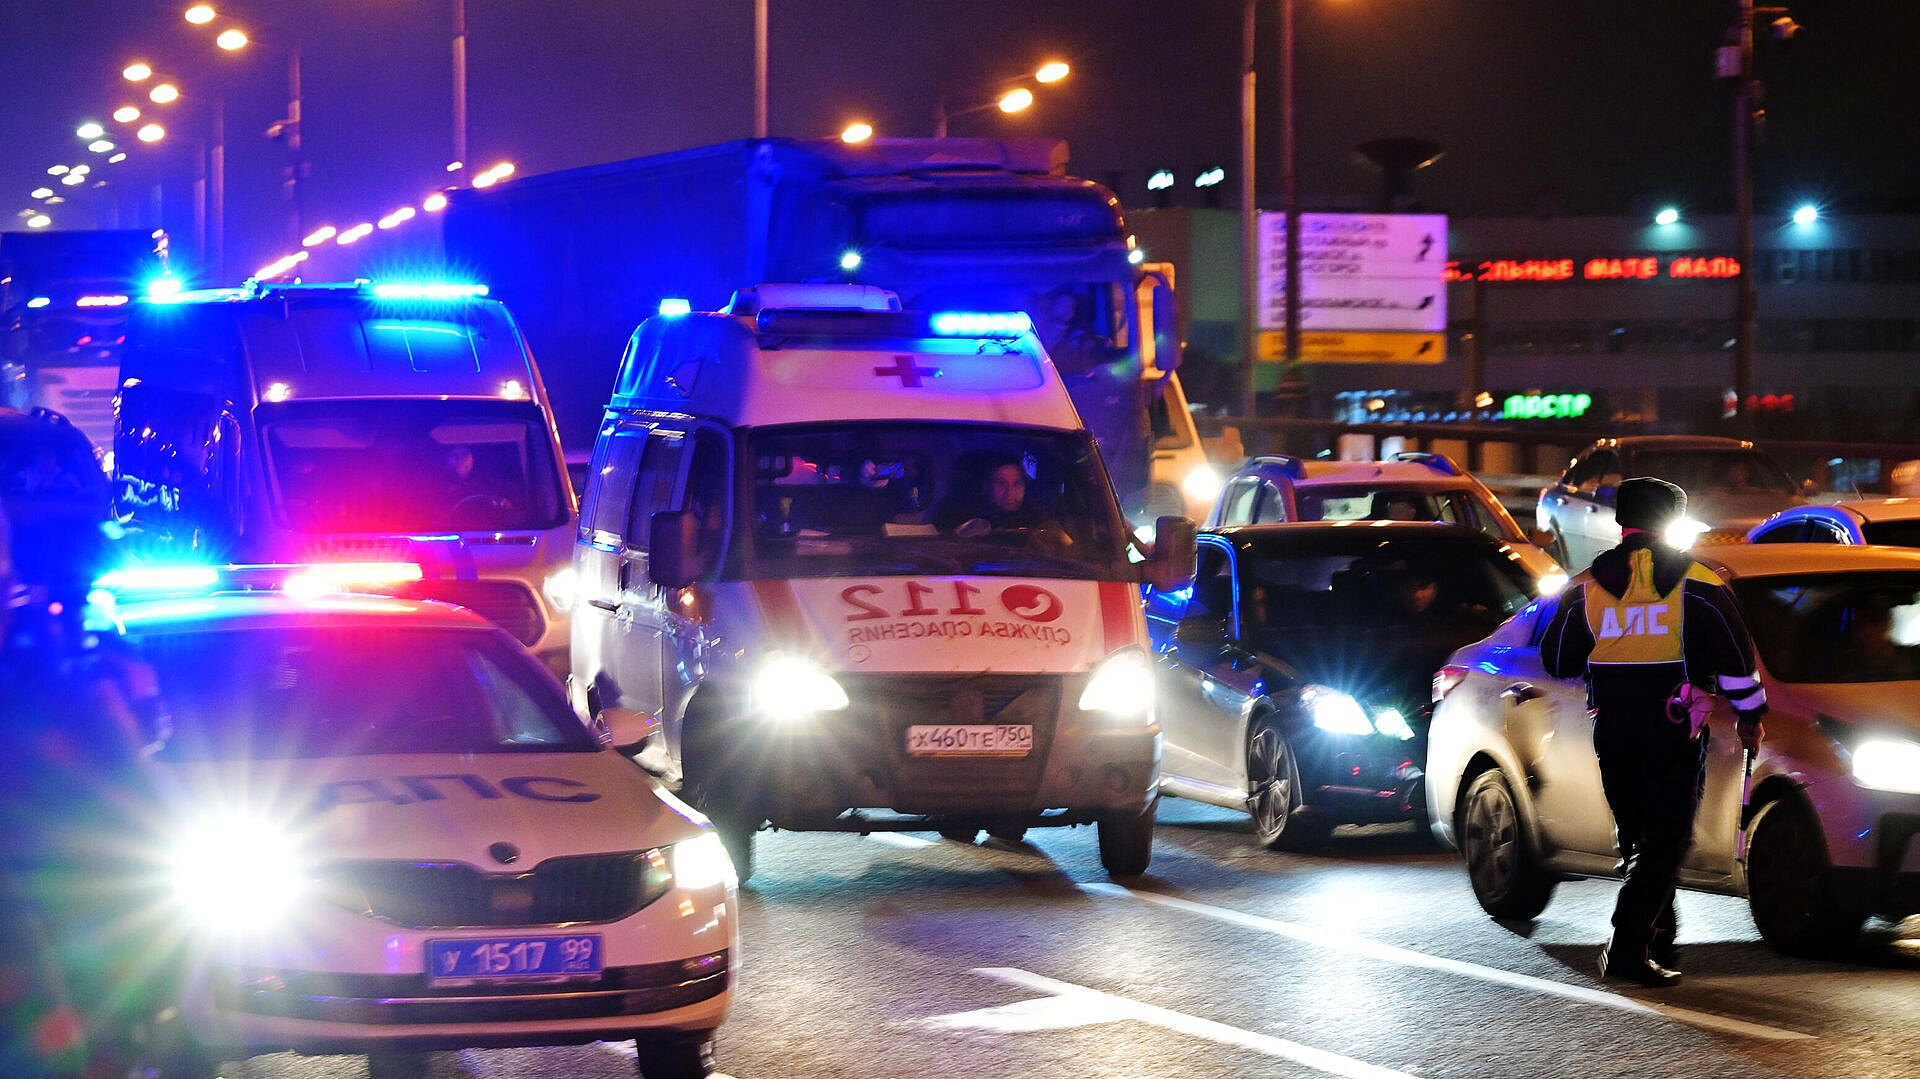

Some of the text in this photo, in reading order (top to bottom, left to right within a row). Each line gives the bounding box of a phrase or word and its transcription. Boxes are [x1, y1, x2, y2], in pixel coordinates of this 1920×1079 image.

[1600, 604, 1669, 638] ДПС
[310, 773, 601, 813] ДПС
[471, 941, 547, 972] 1517
[561, 938, 593, 961] 99
